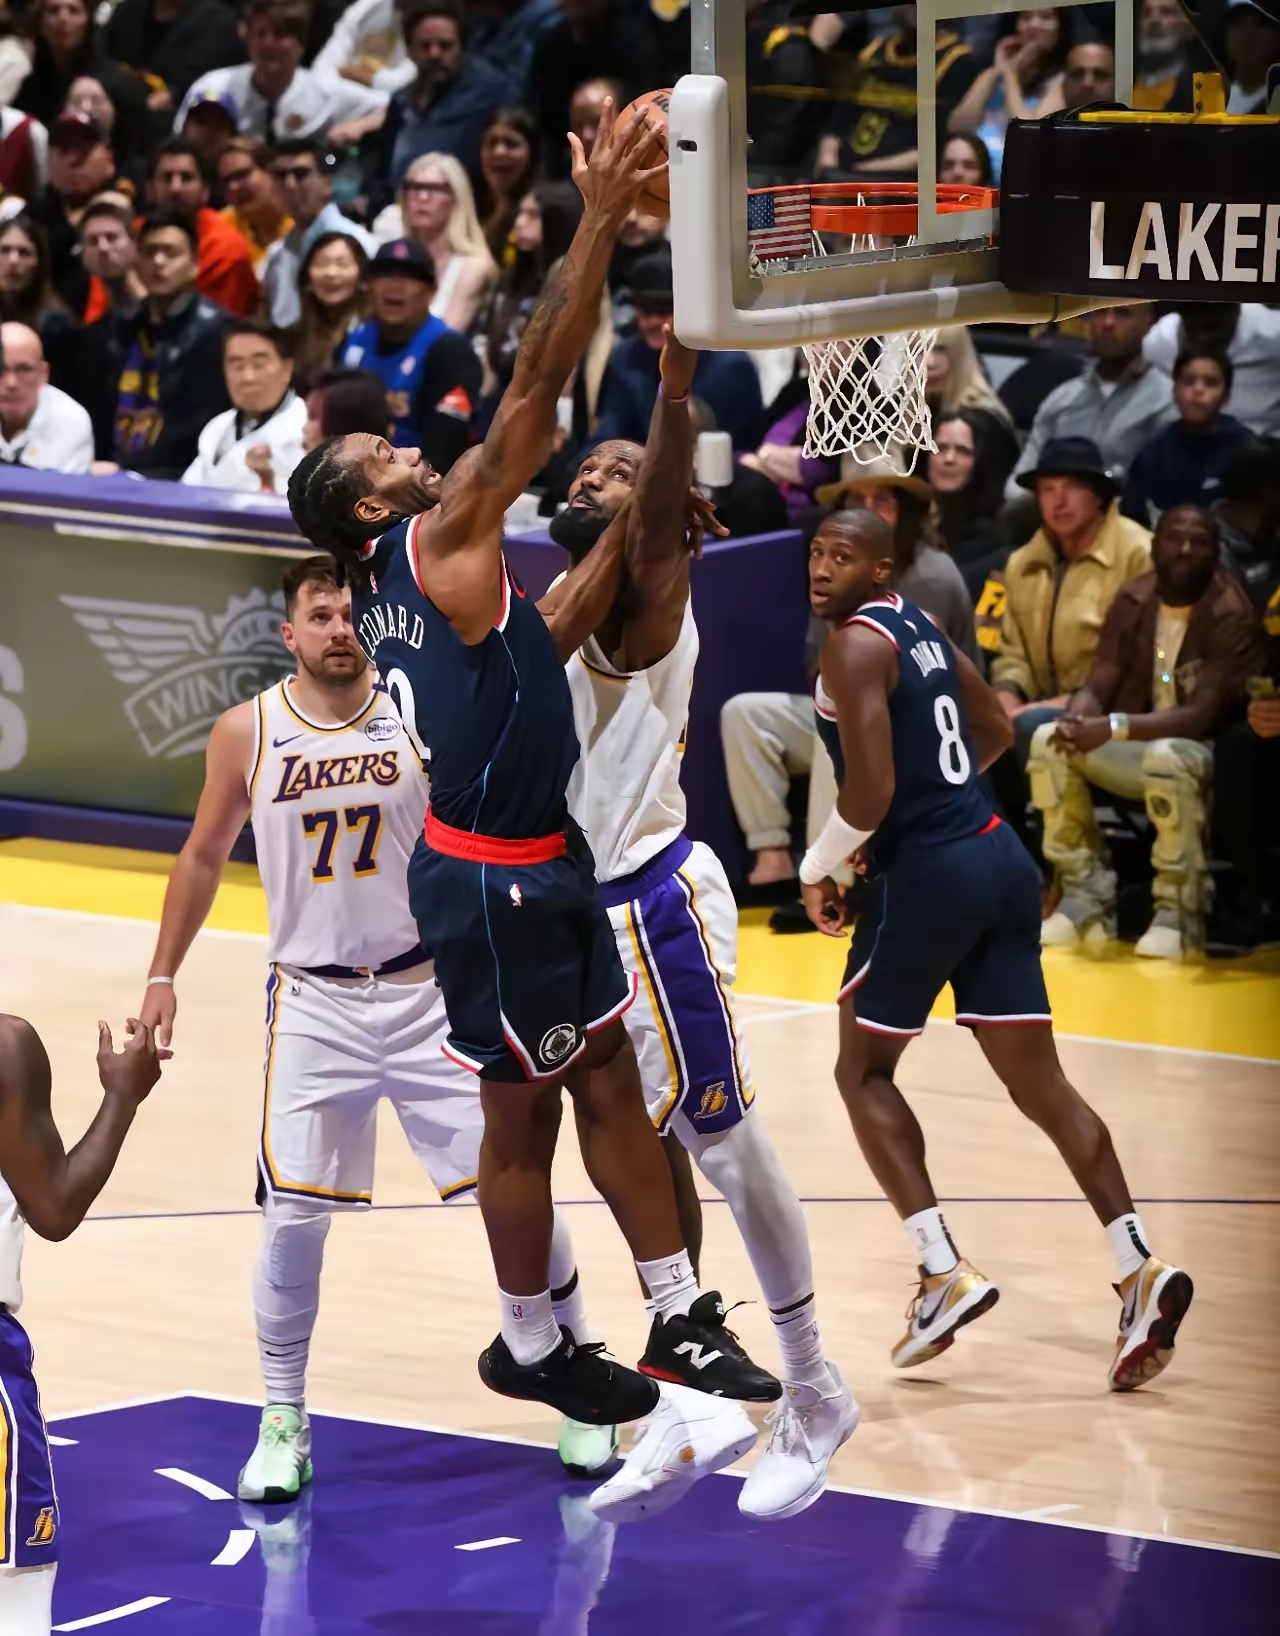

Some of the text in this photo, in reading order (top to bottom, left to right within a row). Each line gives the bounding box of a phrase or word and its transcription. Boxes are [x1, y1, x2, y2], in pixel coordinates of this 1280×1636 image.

[359, 602, 424, 667] EONARD
[367, 723, 398, 734] bibigo
[934, 694, 971, 785] 8
[271, 750, 400, 804] LAKERS
[301, 803, 383, 884] 77
